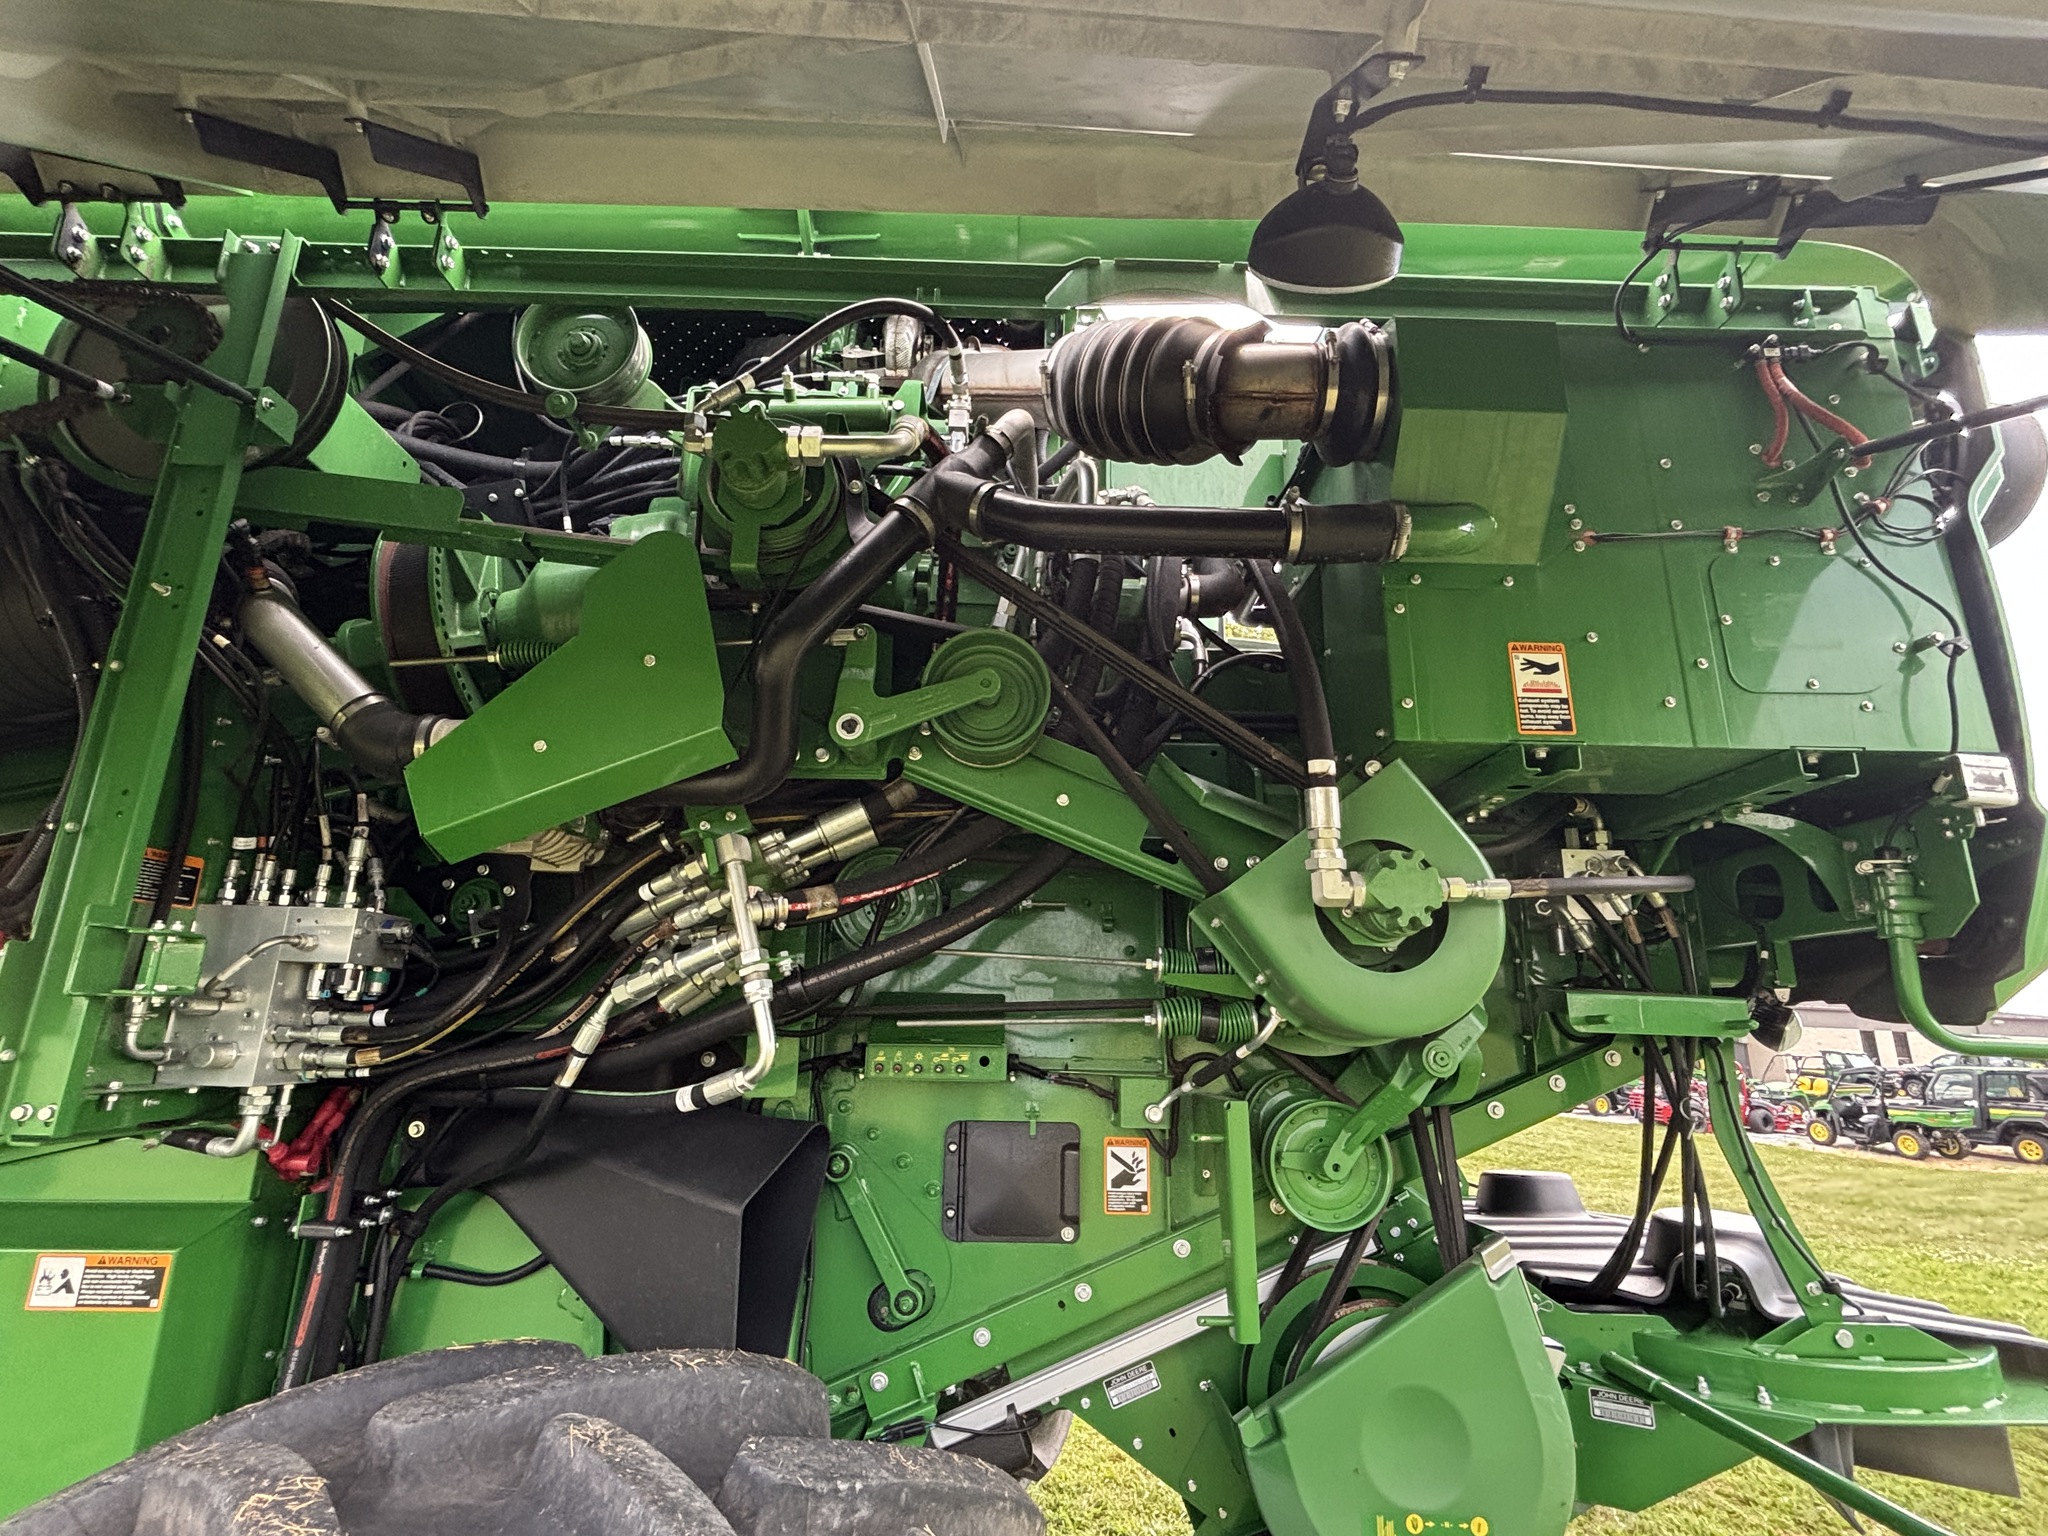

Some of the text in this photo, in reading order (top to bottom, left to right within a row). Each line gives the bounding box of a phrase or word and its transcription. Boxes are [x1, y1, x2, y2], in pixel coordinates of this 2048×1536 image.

[1519, 644, 1562, 652] WARNING
[107, 1256, 159, 1266] WARNING
[1110, 1373, 1127, 1387] JOHN
[1126, 1365, 1148, 1379] DEERE
[1597, 1391, 1645, 1405] JOHN DEERE
